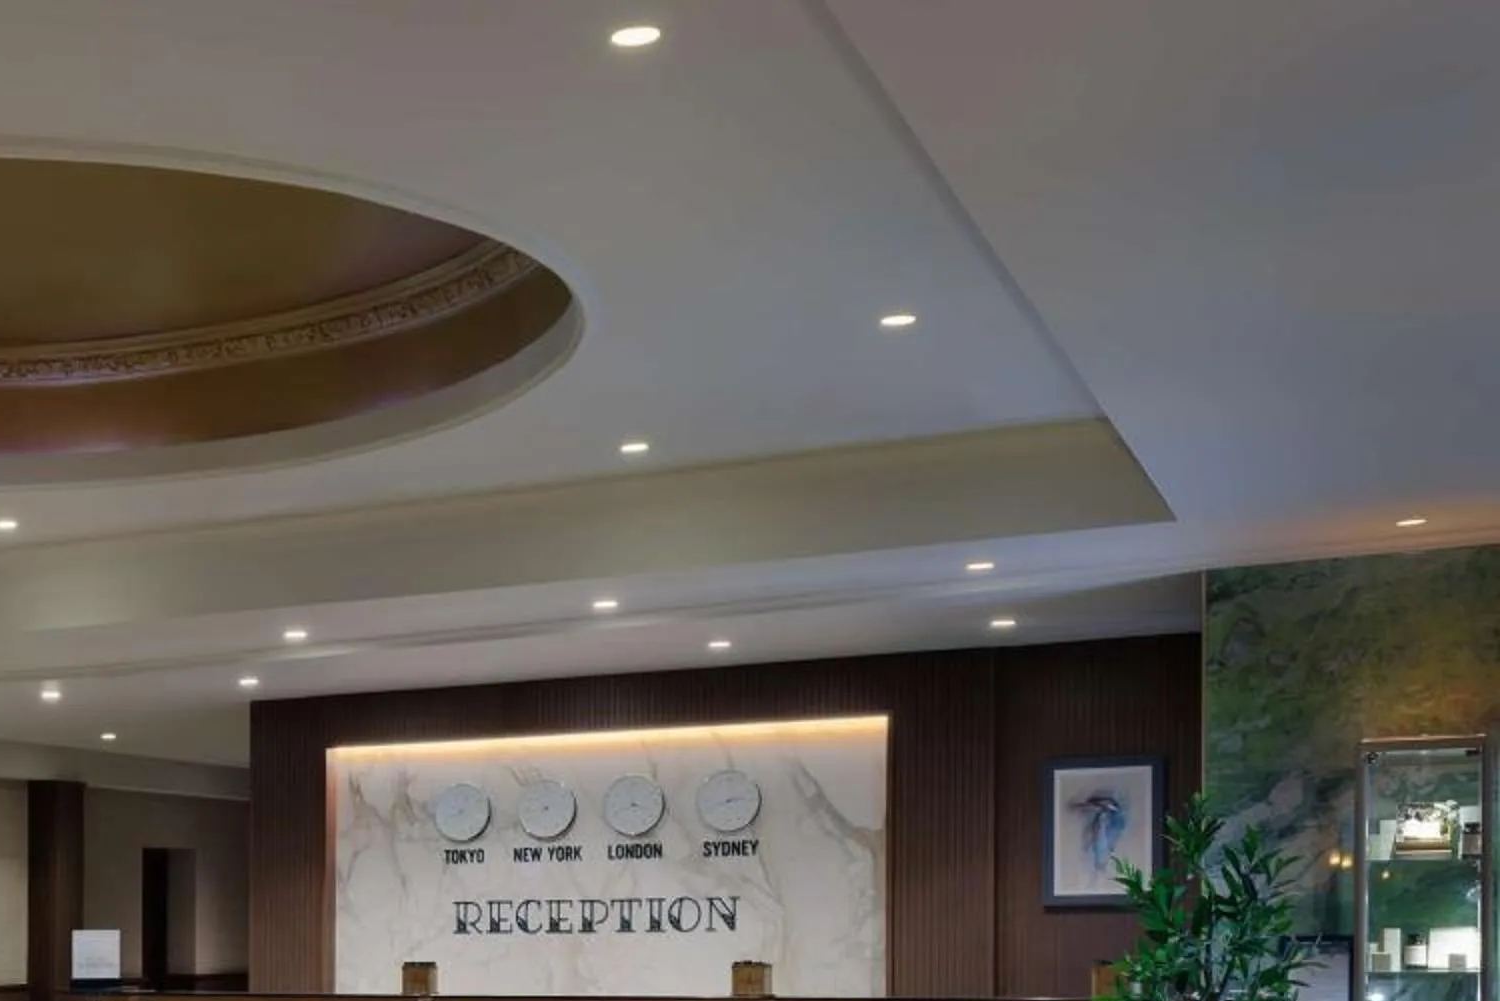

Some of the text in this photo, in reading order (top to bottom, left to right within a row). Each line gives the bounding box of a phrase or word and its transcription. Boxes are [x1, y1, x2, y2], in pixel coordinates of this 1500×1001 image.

[444, 848, 485, 865] TOKYO
[513, 845, 583, 863] NEW YORK
[607, 843, 663, 861] LONDON
[703, 839, 759, 858] SYDNEY
[452, 895, 741, 935] RECEPTION
